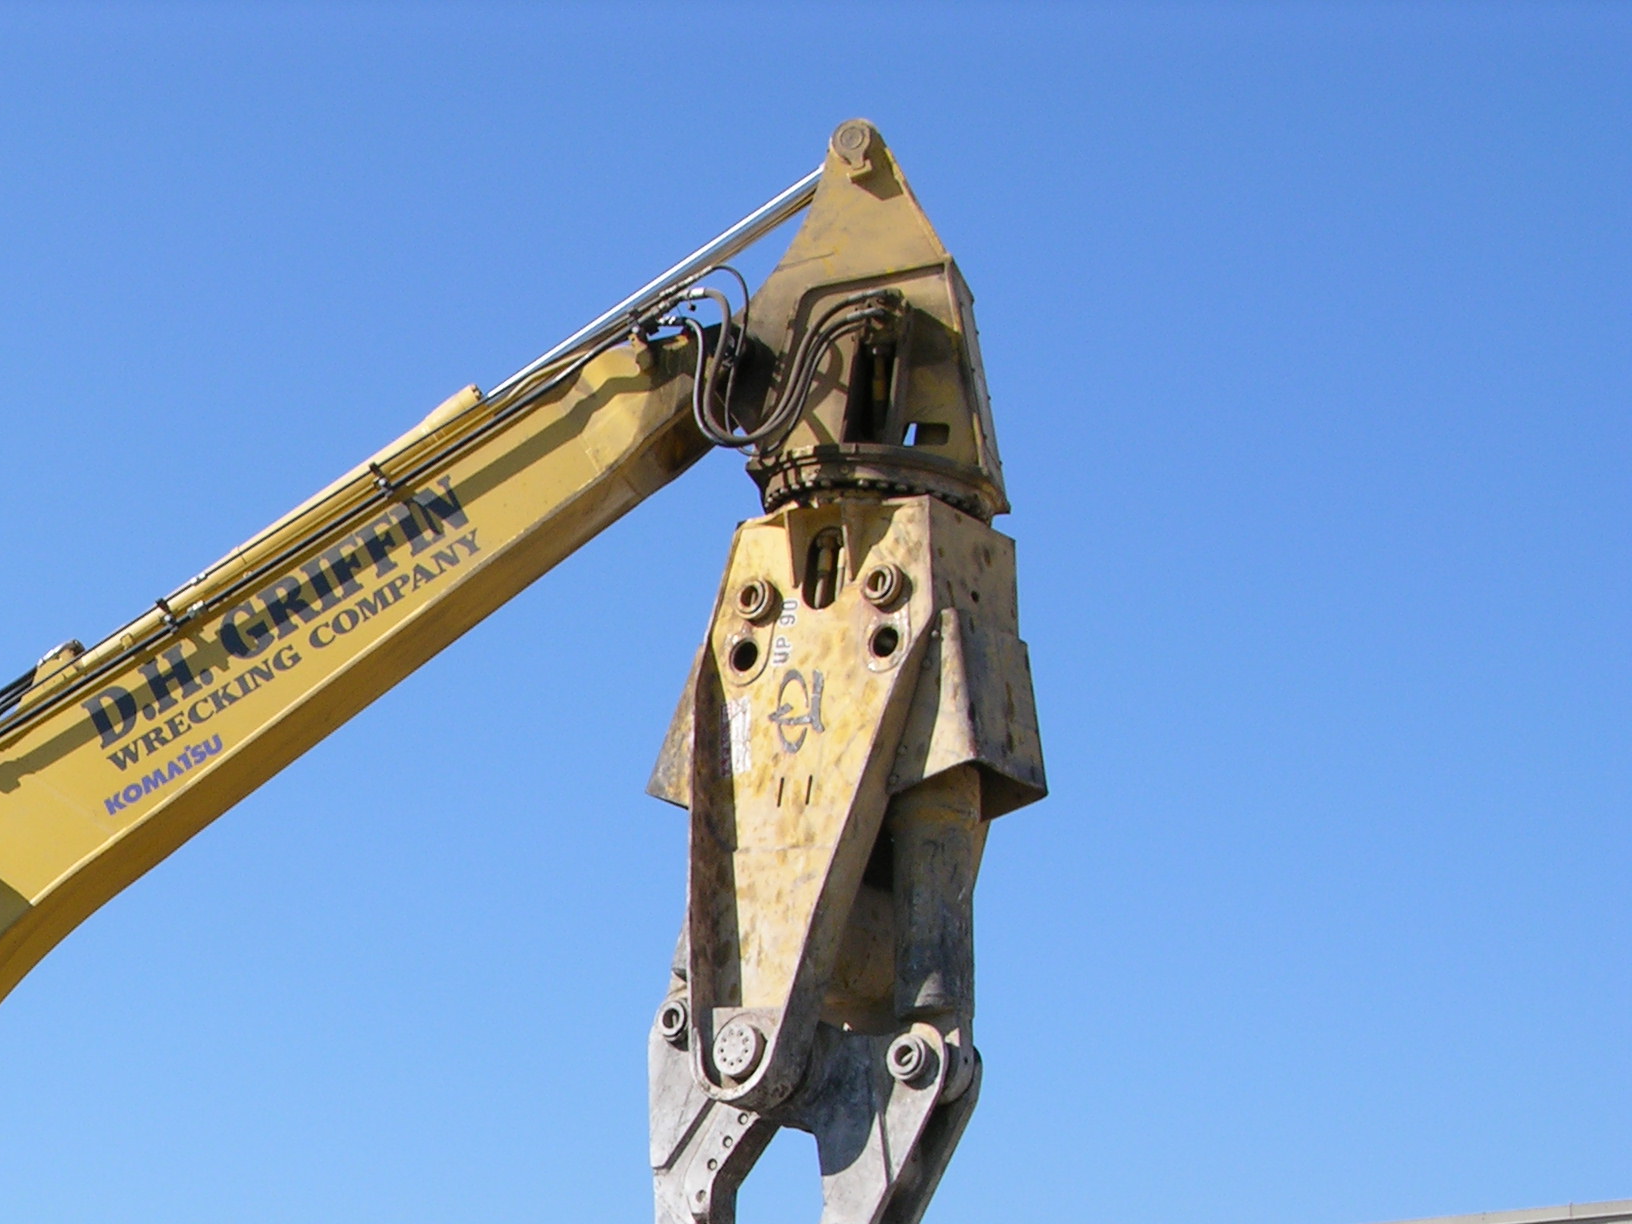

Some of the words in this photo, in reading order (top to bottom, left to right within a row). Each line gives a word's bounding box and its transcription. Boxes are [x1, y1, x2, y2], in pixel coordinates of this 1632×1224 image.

[81, 643, 216, 750] D.H.
[220, 475, 472, 660] GRIFFIN
[106, 643, 301, 773] WRECKING
[309, 528, 484, 650] COMPANY
[773, 636, 793, 667] UP
[780, 599, 799, 627] 90
[104, 734, 223, 816] KOMATSU
